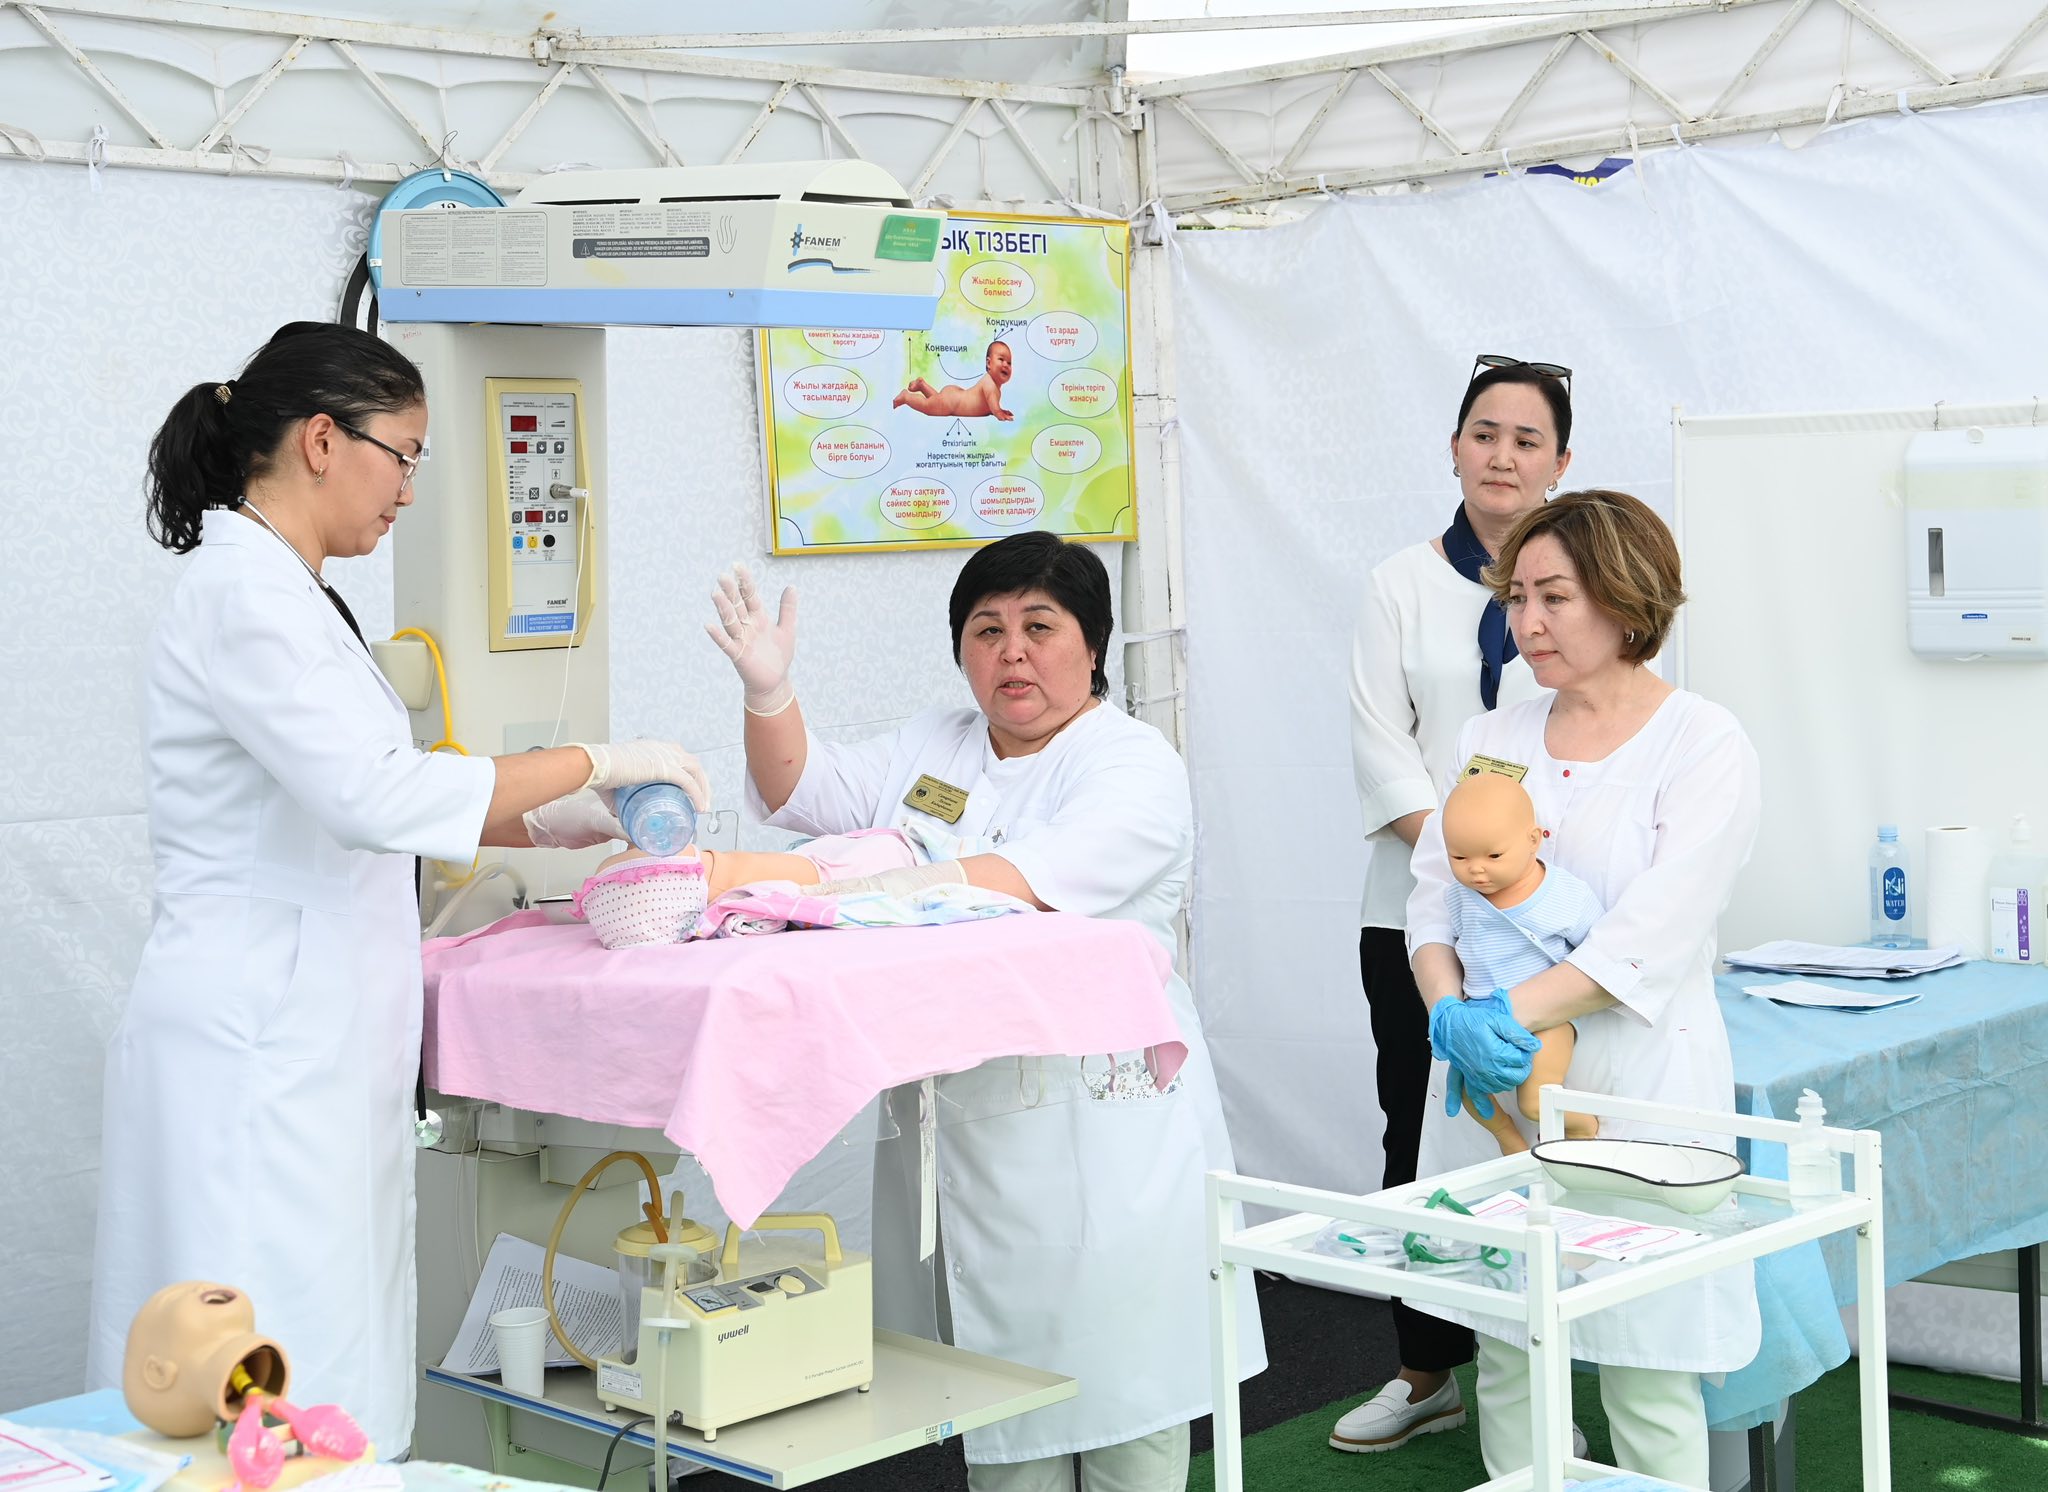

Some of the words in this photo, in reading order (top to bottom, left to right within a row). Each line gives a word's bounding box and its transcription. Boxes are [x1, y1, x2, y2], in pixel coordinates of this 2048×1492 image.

[804, 236, 841, 247] FANEM
[975, 231, 1047, 254] ТІЗБЕГІ
[972, 276, 996, 285] Жылы
[997, 277, 1022, 287] босану
[983, 288, 1012, 296] бөлмесі
[986, 317, 1027, 327] Кондукция
[1046, 326, 1057, 334] Тез
[925, 343, 968, 353] Конвекция
[793, 381, 819, 389] Жылы
[821, 381, 858, 390] жағдайда
[803, 394, 851, 403] тасымалдау
[817, 442, 832, 450] Ана
[850, 441, 885, 450] баланың
[942, 439, 977, 447] Өткізгіштік
[828, 453, 848, 462] бірге
[850, 453, 874, 462] болуы
[967, 453, 995, 461] жылуды
[890, 488, 912, 497] Жылу
[914, 488, 945, 496] сақтауға
[886, 499, 911, 507] сәйкес
[913, 500, 930, 508] орау
[981, 497, 1035, 505] шомылдыруды
[895, 510, 941, 518] шомылдыру
[979, 507, 1004, 515] кейінге
[1006, 508, 1037, 516] қалдыру
[717, 1324, 750, 1344] yuwell
